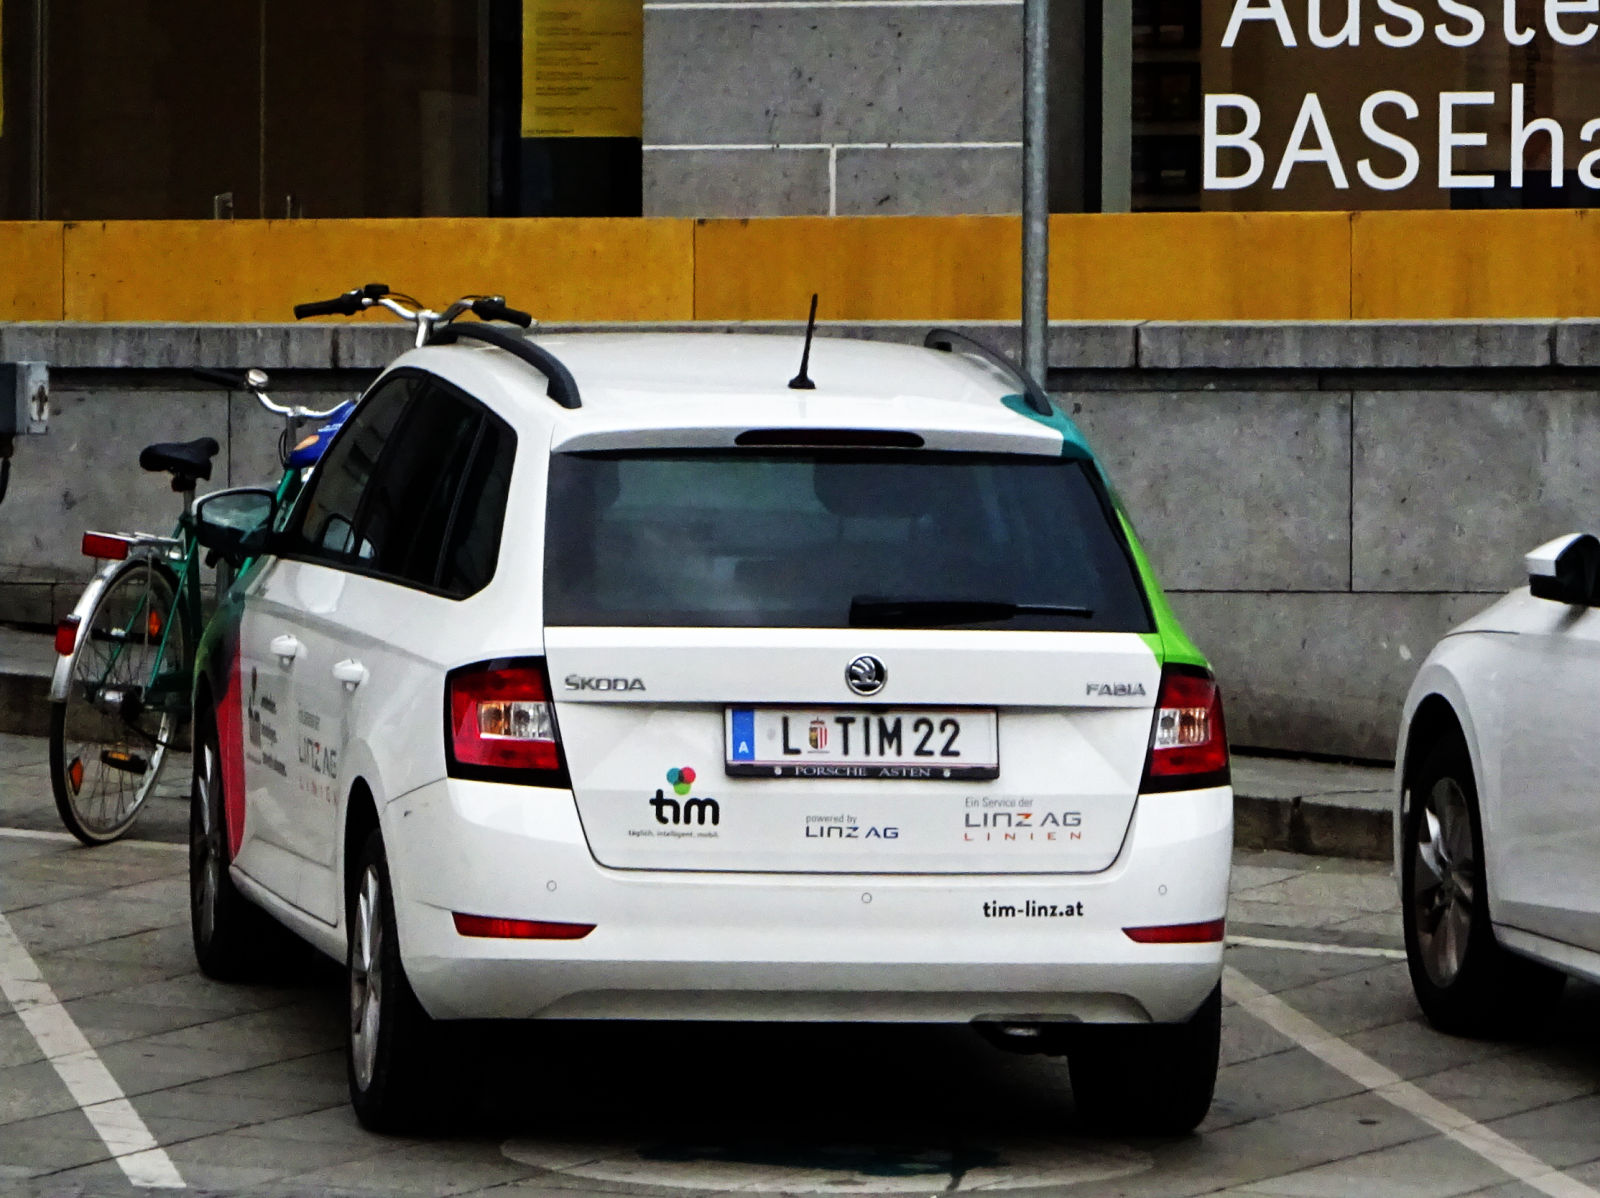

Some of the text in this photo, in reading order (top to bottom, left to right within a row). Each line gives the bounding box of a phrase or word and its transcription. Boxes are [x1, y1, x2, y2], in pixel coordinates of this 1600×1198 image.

[1086, 682, 1146, 696] FABIA
[738, 741, 749, 754] A
[782, 716, 801, 755] L
[795, 766, 931, 778] PORSCHE ASTEN
[649, 788, 720, 826] tim
[965, 797, 1033, 808] Ein Service der
[805, 814, 857, 824] powered by
[1040, 812, 1082, 827] AG
[865, 826, 899, 839] AG
[963, 831, 1082, 842] LINIEN
[983, 900, 1084, 917] tim-linz.at
